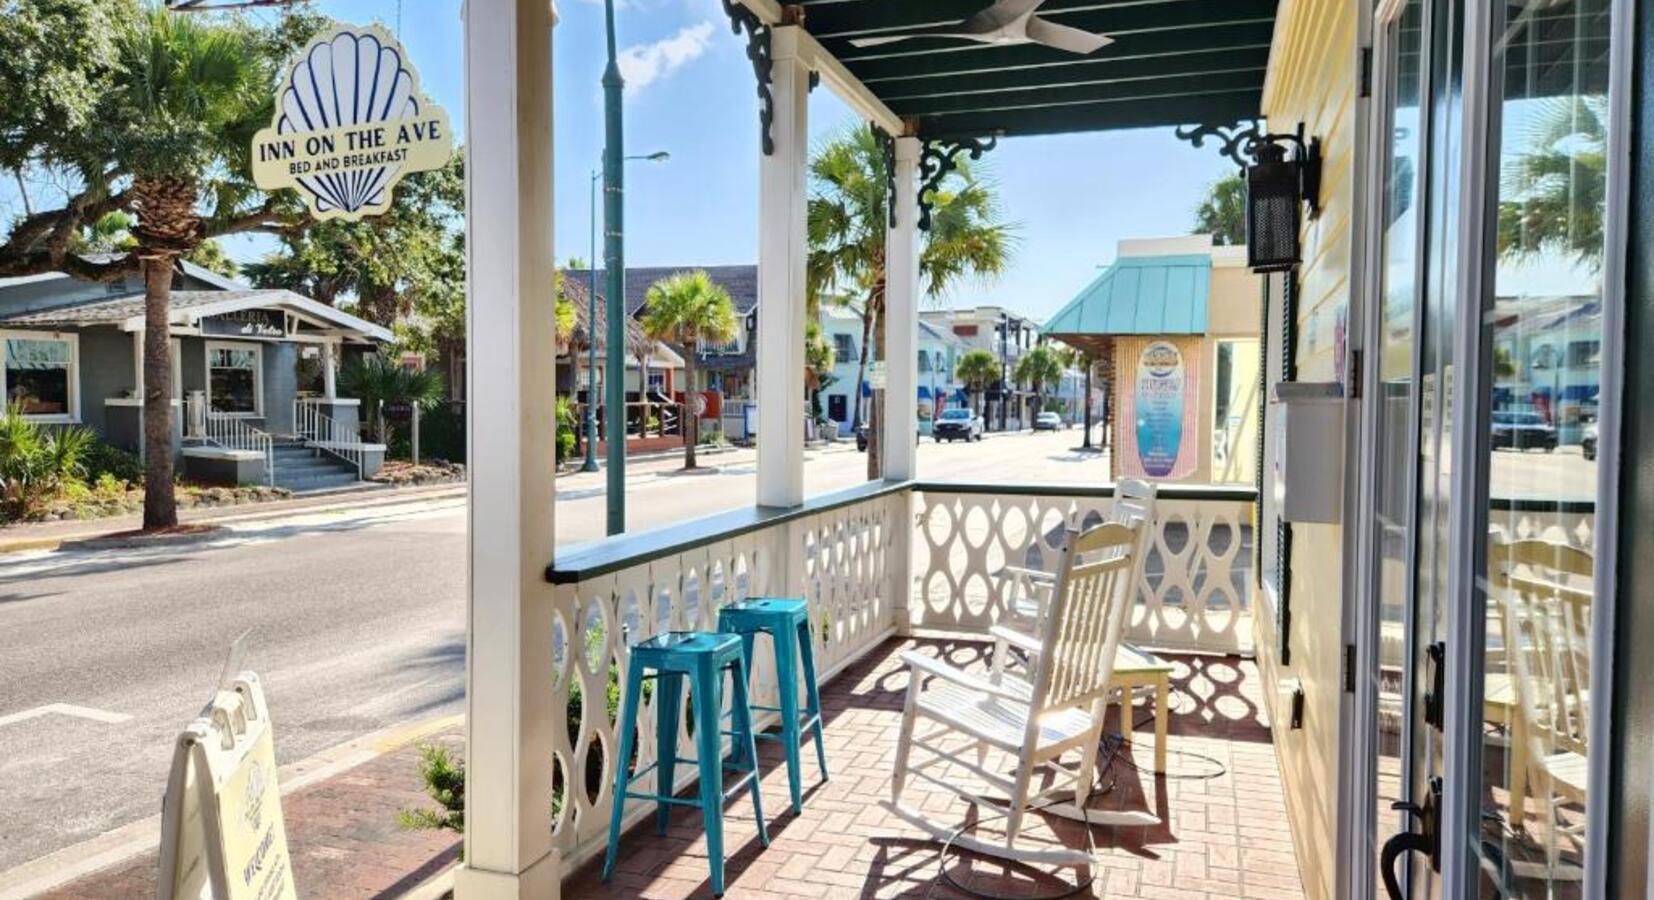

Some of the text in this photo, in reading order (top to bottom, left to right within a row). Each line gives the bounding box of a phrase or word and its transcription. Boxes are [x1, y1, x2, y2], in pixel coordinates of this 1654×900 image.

[259, 120, 441, 162] INN ON THE AVE
[289, 148, 408, 175] BED AND BREAKFAST
